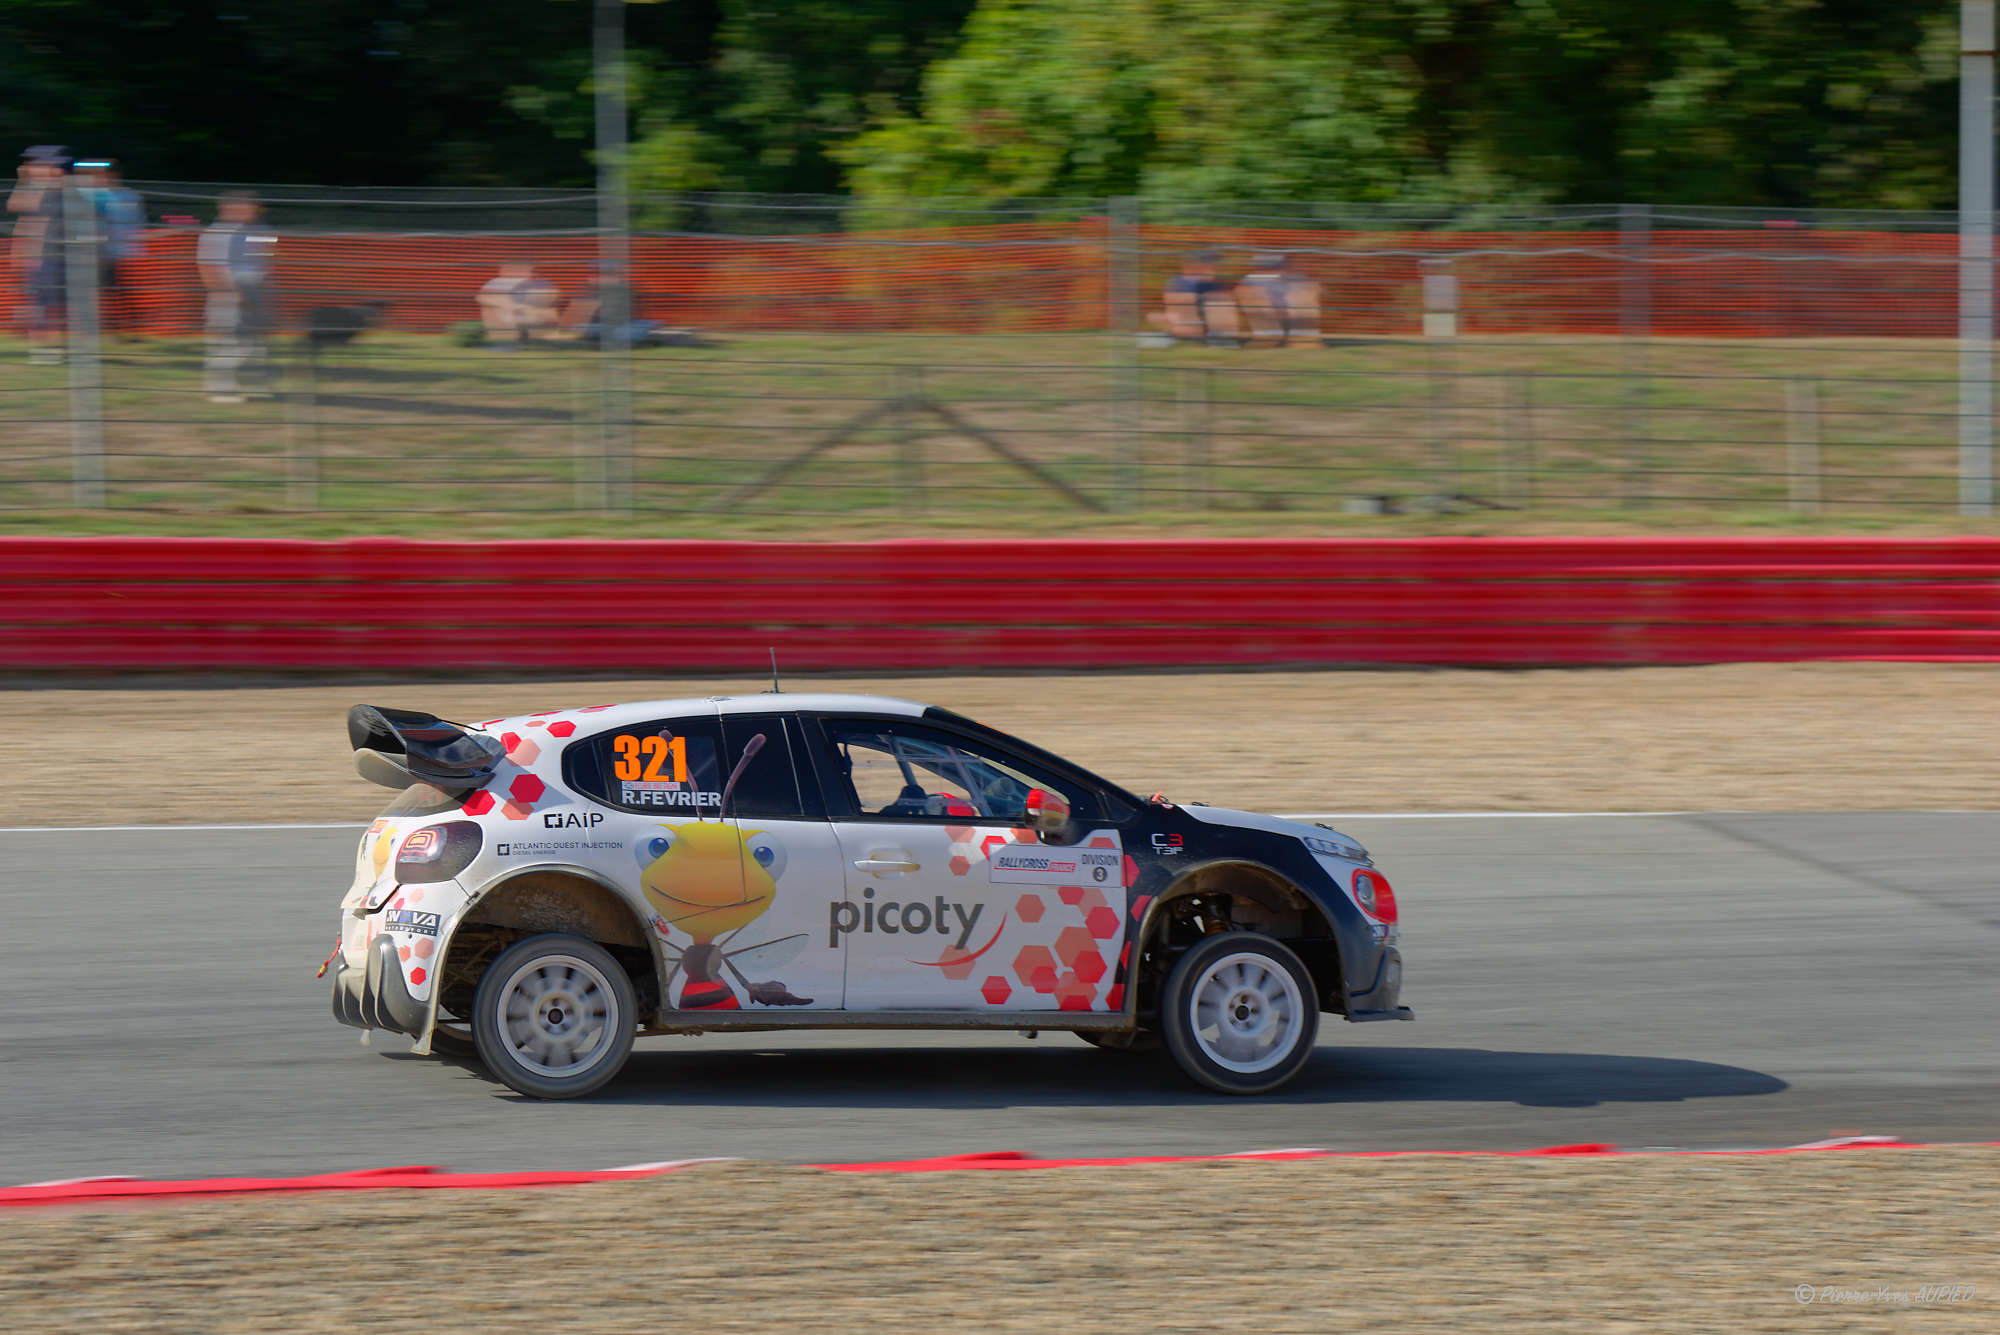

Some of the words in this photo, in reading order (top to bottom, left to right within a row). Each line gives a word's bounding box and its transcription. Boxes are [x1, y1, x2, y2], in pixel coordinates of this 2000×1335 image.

[613, 735, 688, 782] 321
[621, 790, 722, 806] R.FEVRIER
[512, 842, 553, 850] ATLANTIC
[553, 841, 580, 849] OUEST
[581, 841, 623, 849] INJECTION
[1151, 833, 1184, 846] C3
[998, 856, 1050, 870] RALLYCROSS
[1081, 853, 1119, 867] DIVISION
[829, 887, 985, 950] picoty
